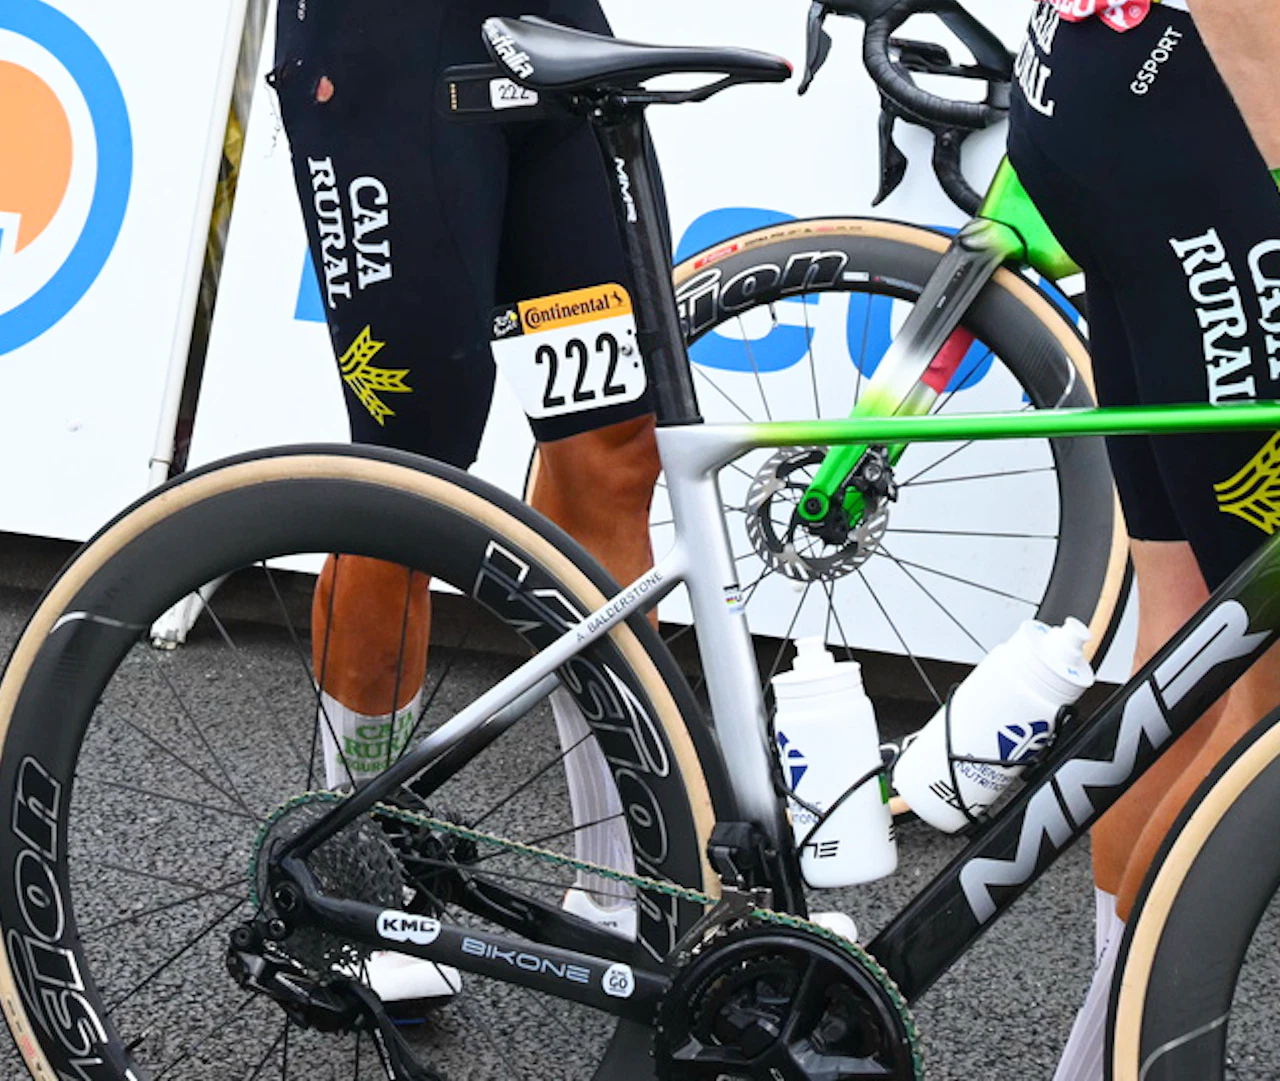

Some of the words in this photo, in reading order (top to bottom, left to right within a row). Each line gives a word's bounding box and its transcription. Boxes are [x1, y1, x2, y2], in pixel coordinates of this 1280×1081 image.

[1130, 25, 1183, 97] GSPORT
[307, 156, 352, 309] RURAL
[348, 175, 393, 290] CAJA
[525, 294, 610, 329] Continental
[1169, 227, 1256, 405] RURAL
[535, 331, 626, 408] 222
[587, 571, 663, 633] BALDERSTONE
[959, 599, 1273, 925] MMR
[383, 918, 437, 933] KMC
[461, 936, 592, 985] BIKONE
